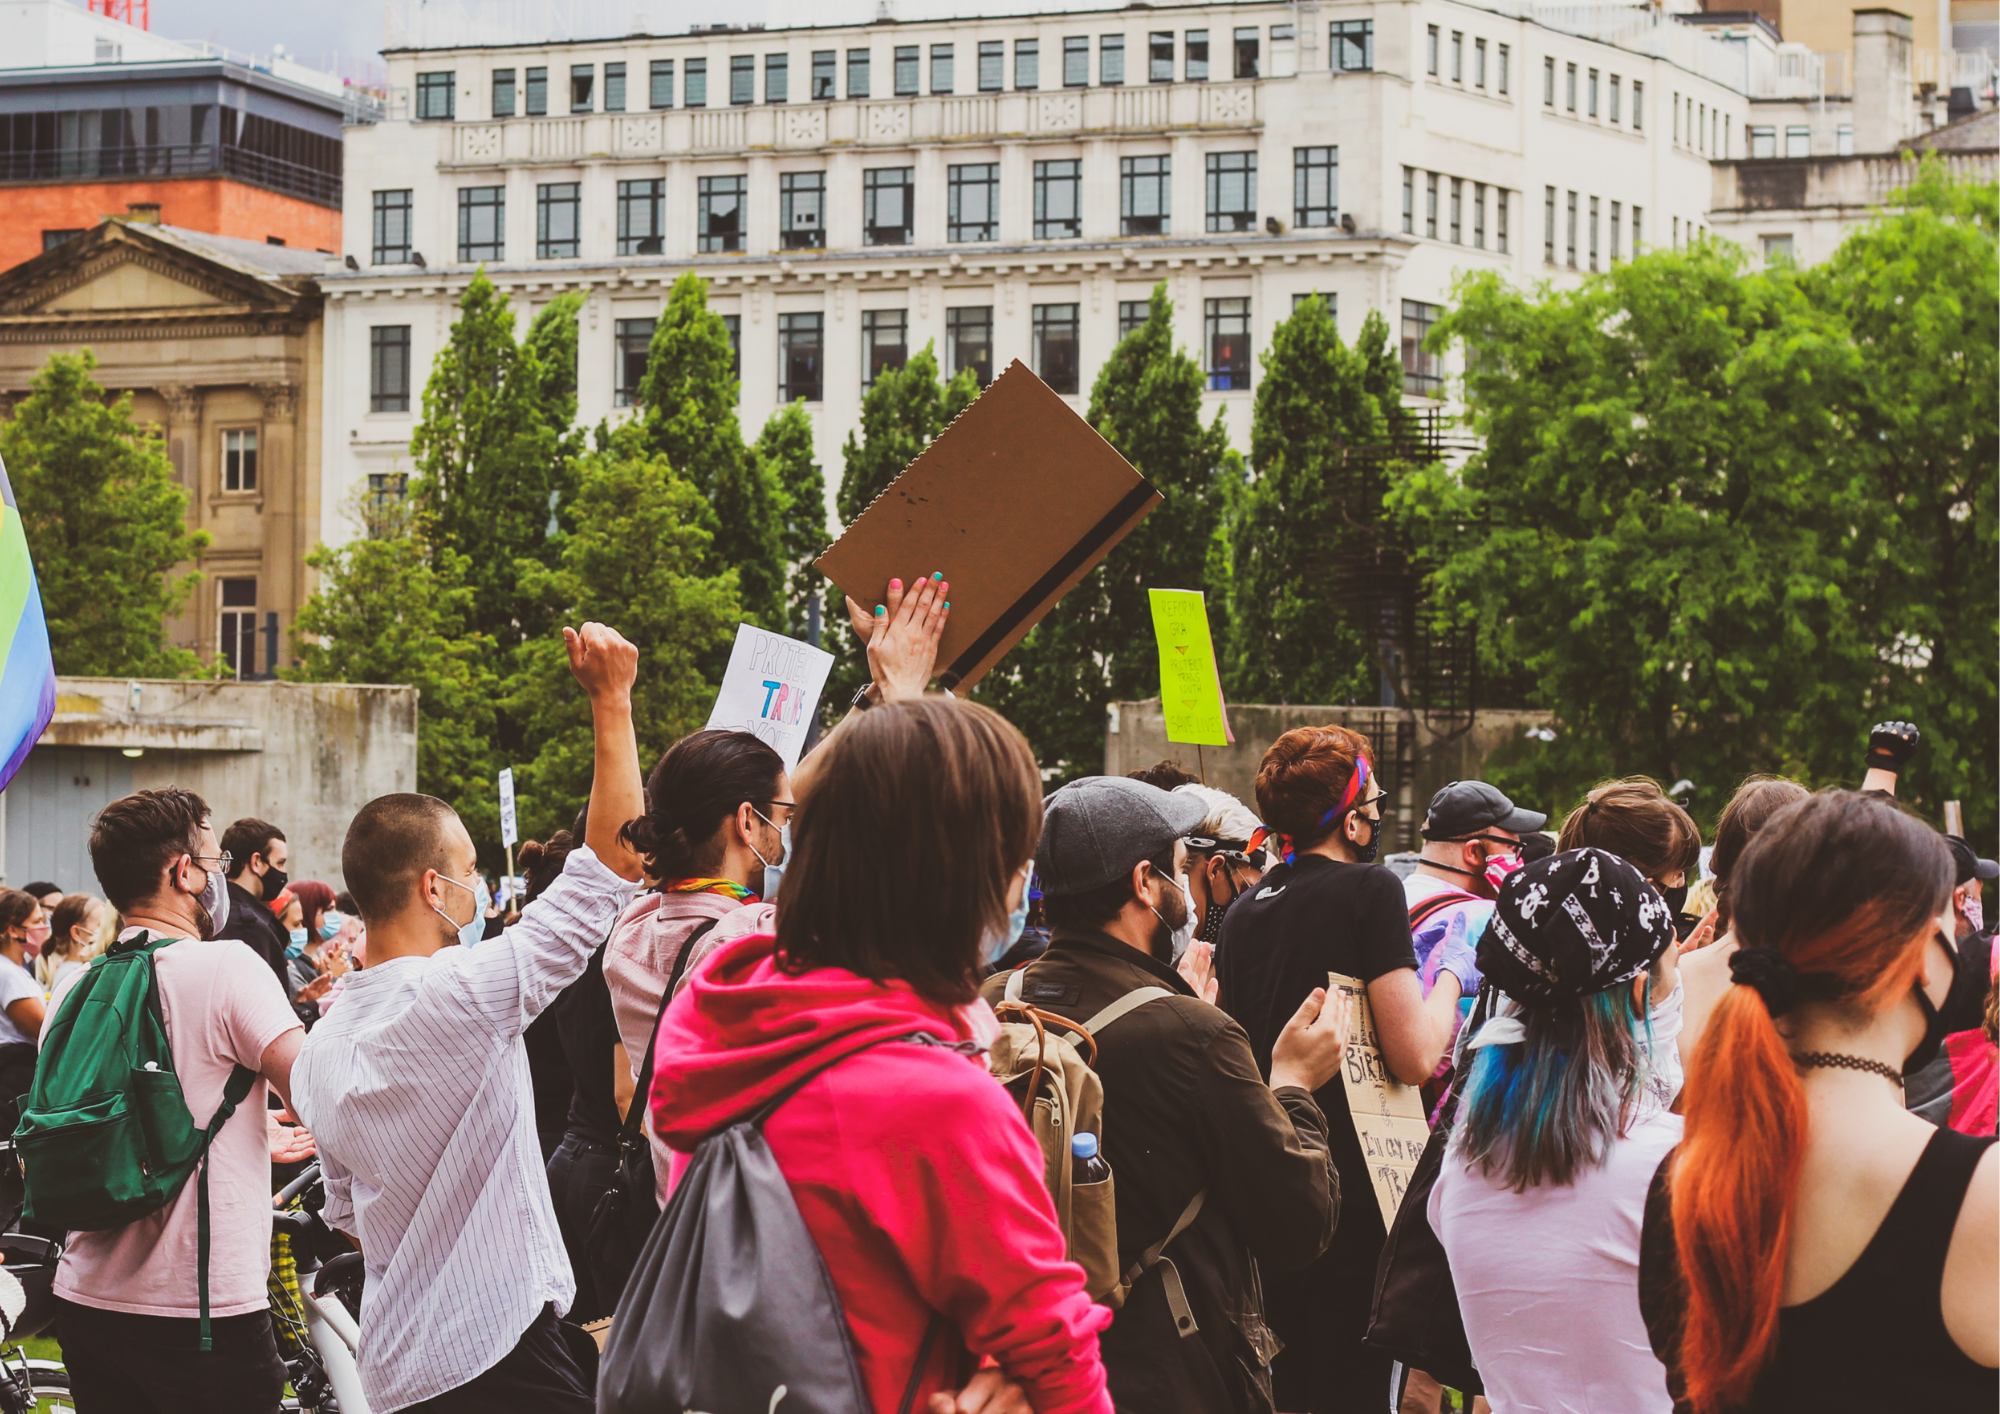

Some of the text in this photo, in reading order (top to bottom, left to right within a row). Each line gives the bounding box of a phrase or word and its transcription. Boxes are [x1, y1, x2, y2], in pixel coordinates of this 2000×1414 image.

[1161, 599, 1198, 619] REFORM
[1169, 622, 1188, 636] GRA
[1170, 658, 1204, 671] PROTECT
[1177, 672, 1201, 683] TRANS
[1179, 684, 1203, 694] YOUTH
[1170, 715, 1223, 734] SAVE LIVES
